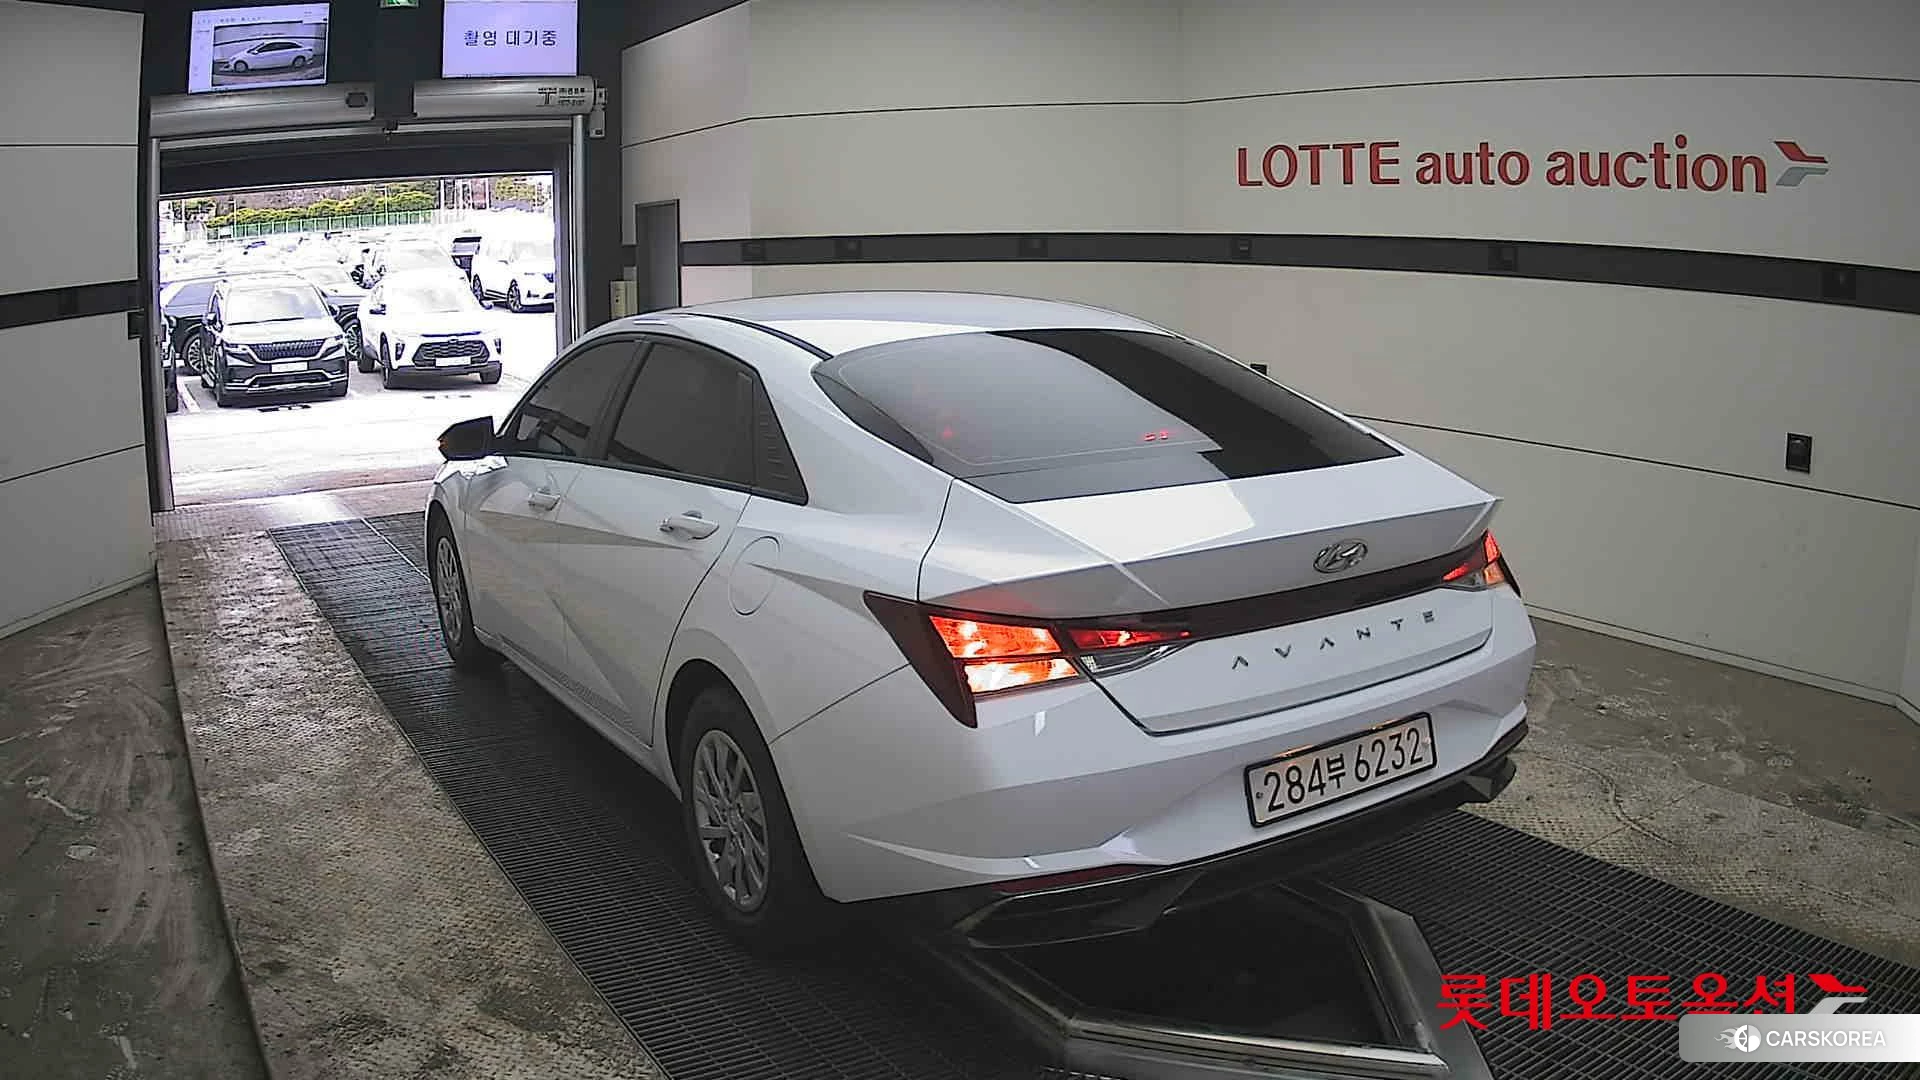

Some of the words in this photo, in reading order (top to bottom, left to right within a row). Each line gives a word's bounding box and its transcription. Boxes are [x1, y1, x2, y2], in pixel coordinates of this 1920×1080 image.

[506, 30, 557, 46] 대기중
[1237, 141, 1400, 188] LOTTE
[1415, 142, 1531, 186] auto
[1546, 134, 1767, 193] auction
[1232, 610, 1434, 669] AVANTE
[1264, 753, 1346, 812] 284부
[1355, 727, 1423, 782] 6232
